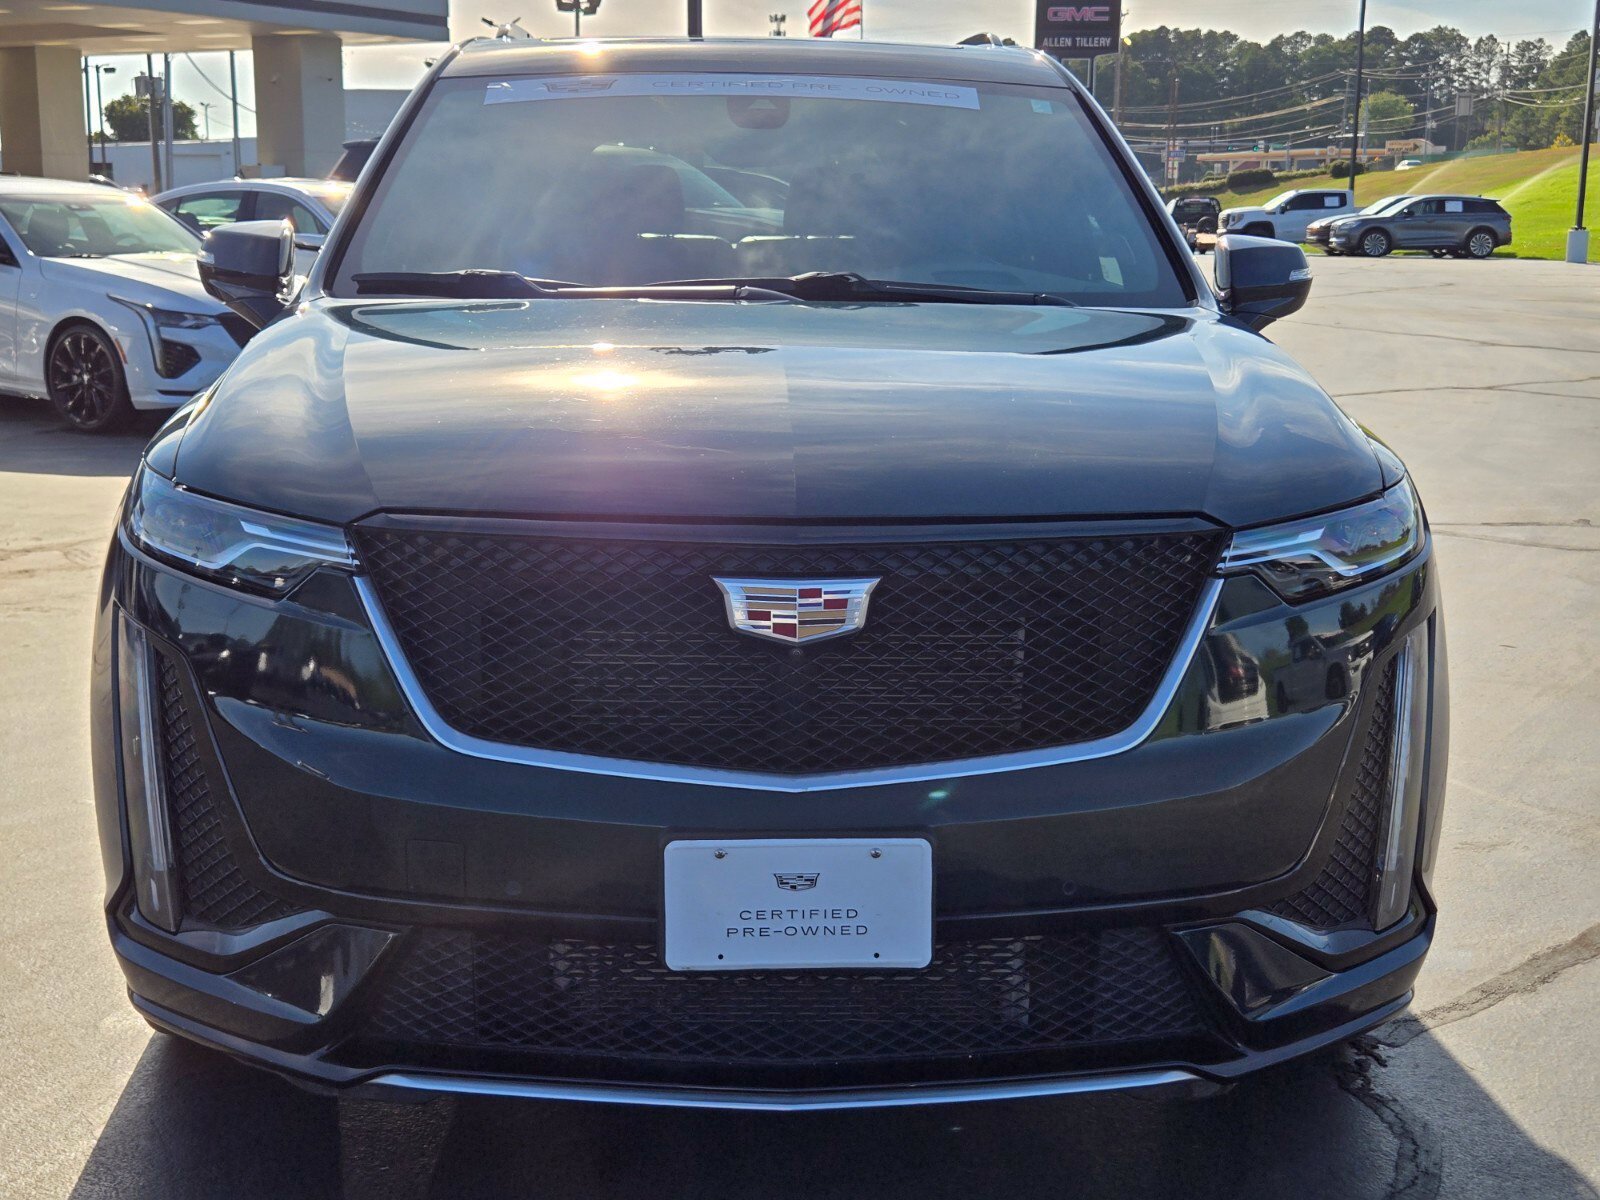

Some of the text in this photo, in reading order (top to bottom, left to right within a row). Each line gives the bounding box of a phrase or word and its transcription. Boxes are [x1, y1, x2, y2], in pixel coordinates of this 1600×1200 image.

[1047, 6, 1110, 22] GMC
[1042, 36, 1112, 48] ALLEN TILLERY
[651, 80, 784, 90] CERTIFIED
[739, 908, 859, 921] CERTIFIED
[726, 925, 869, 938] PRE-OWNED
